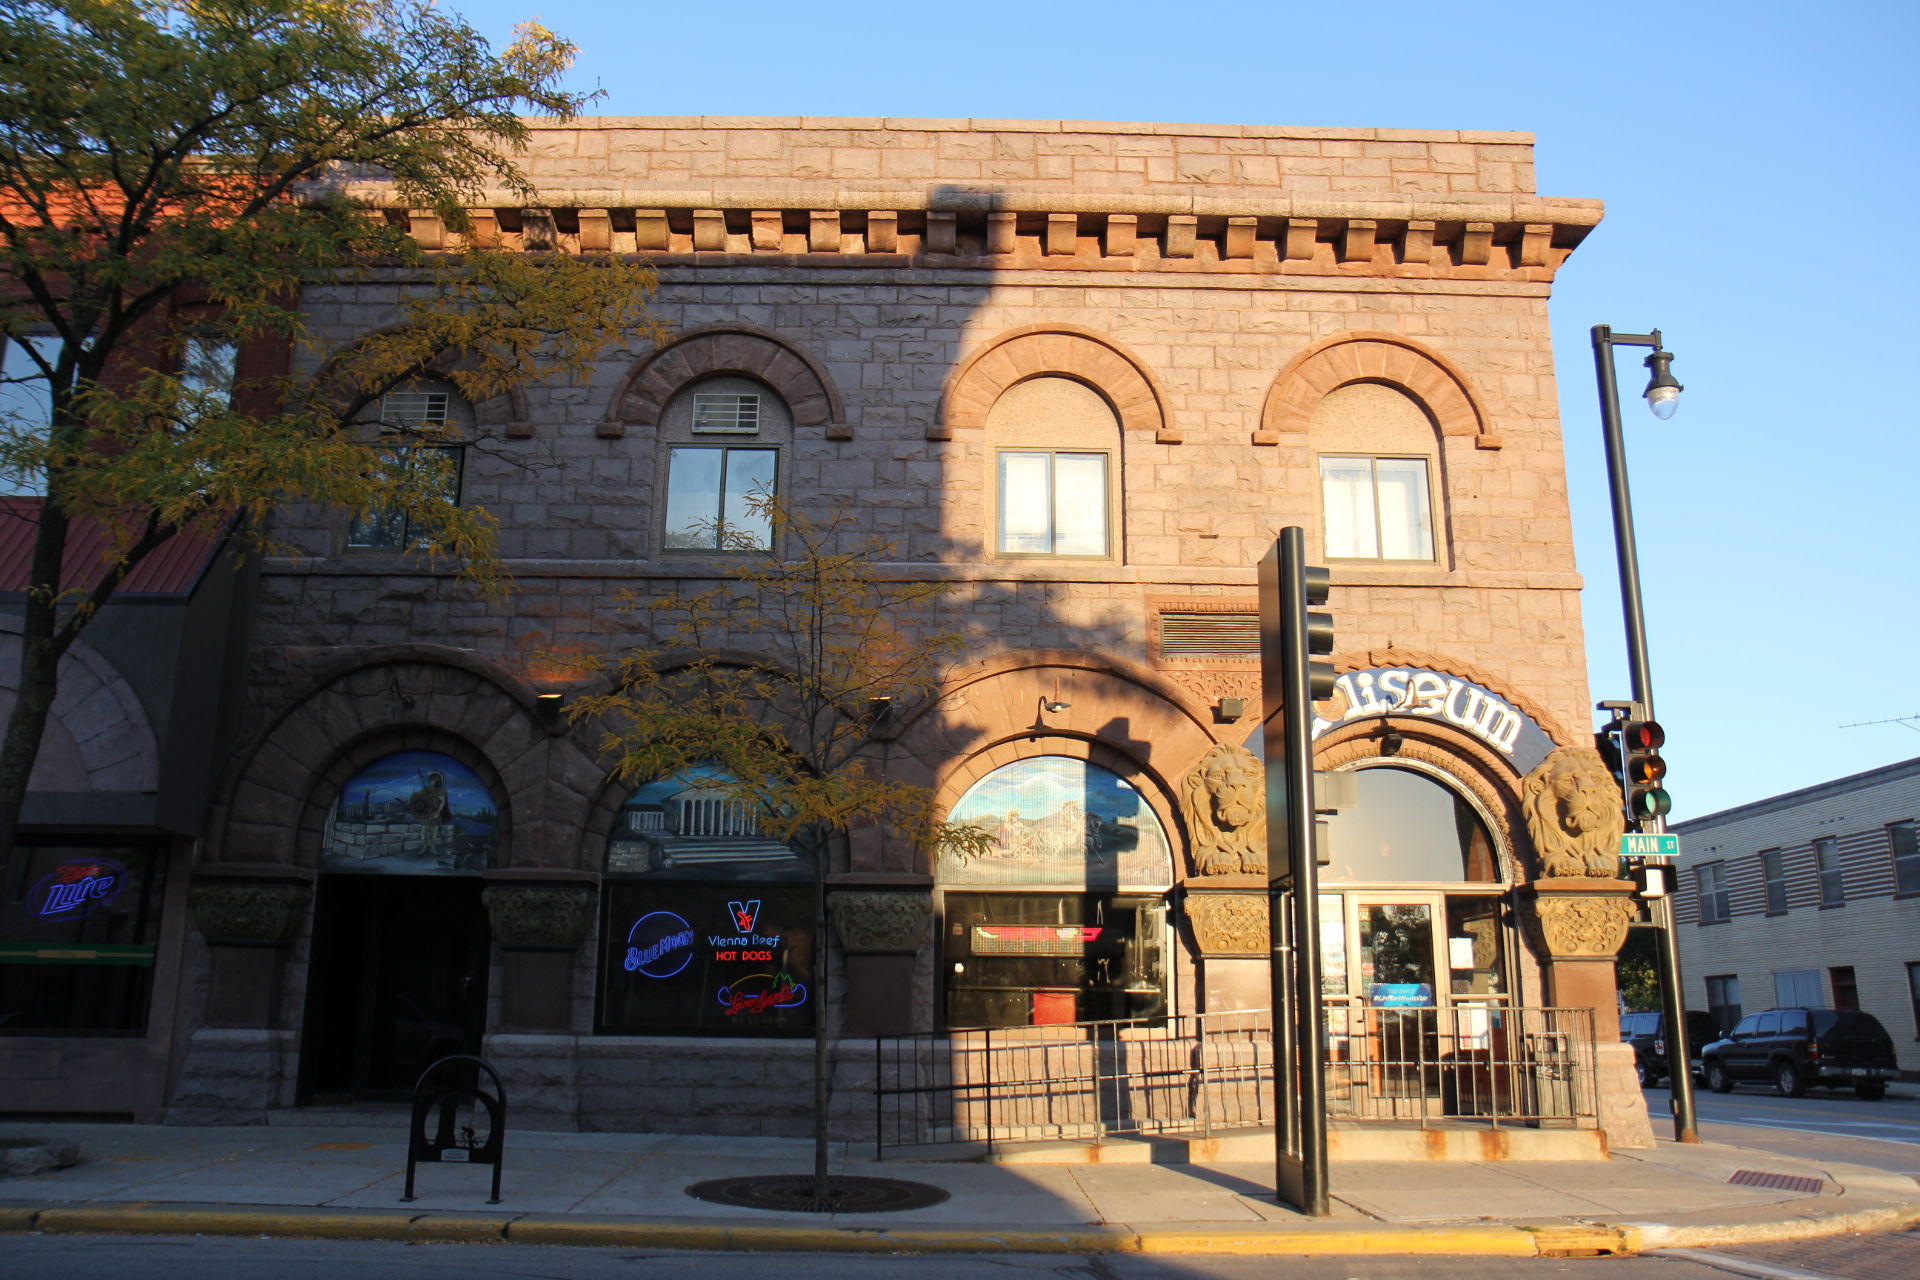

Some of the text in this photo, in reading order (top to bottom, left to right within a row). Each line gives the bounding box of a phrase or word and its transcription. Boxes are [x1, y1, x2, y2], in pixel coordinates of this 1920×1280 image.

[1311, 670, 1522, 755] oliseum
[1627, 836, 1675, 853] MAIN ST
[708, 934, 780, 948] Vienna Beef
[716, 950, 772, 961] HOT DOGS
